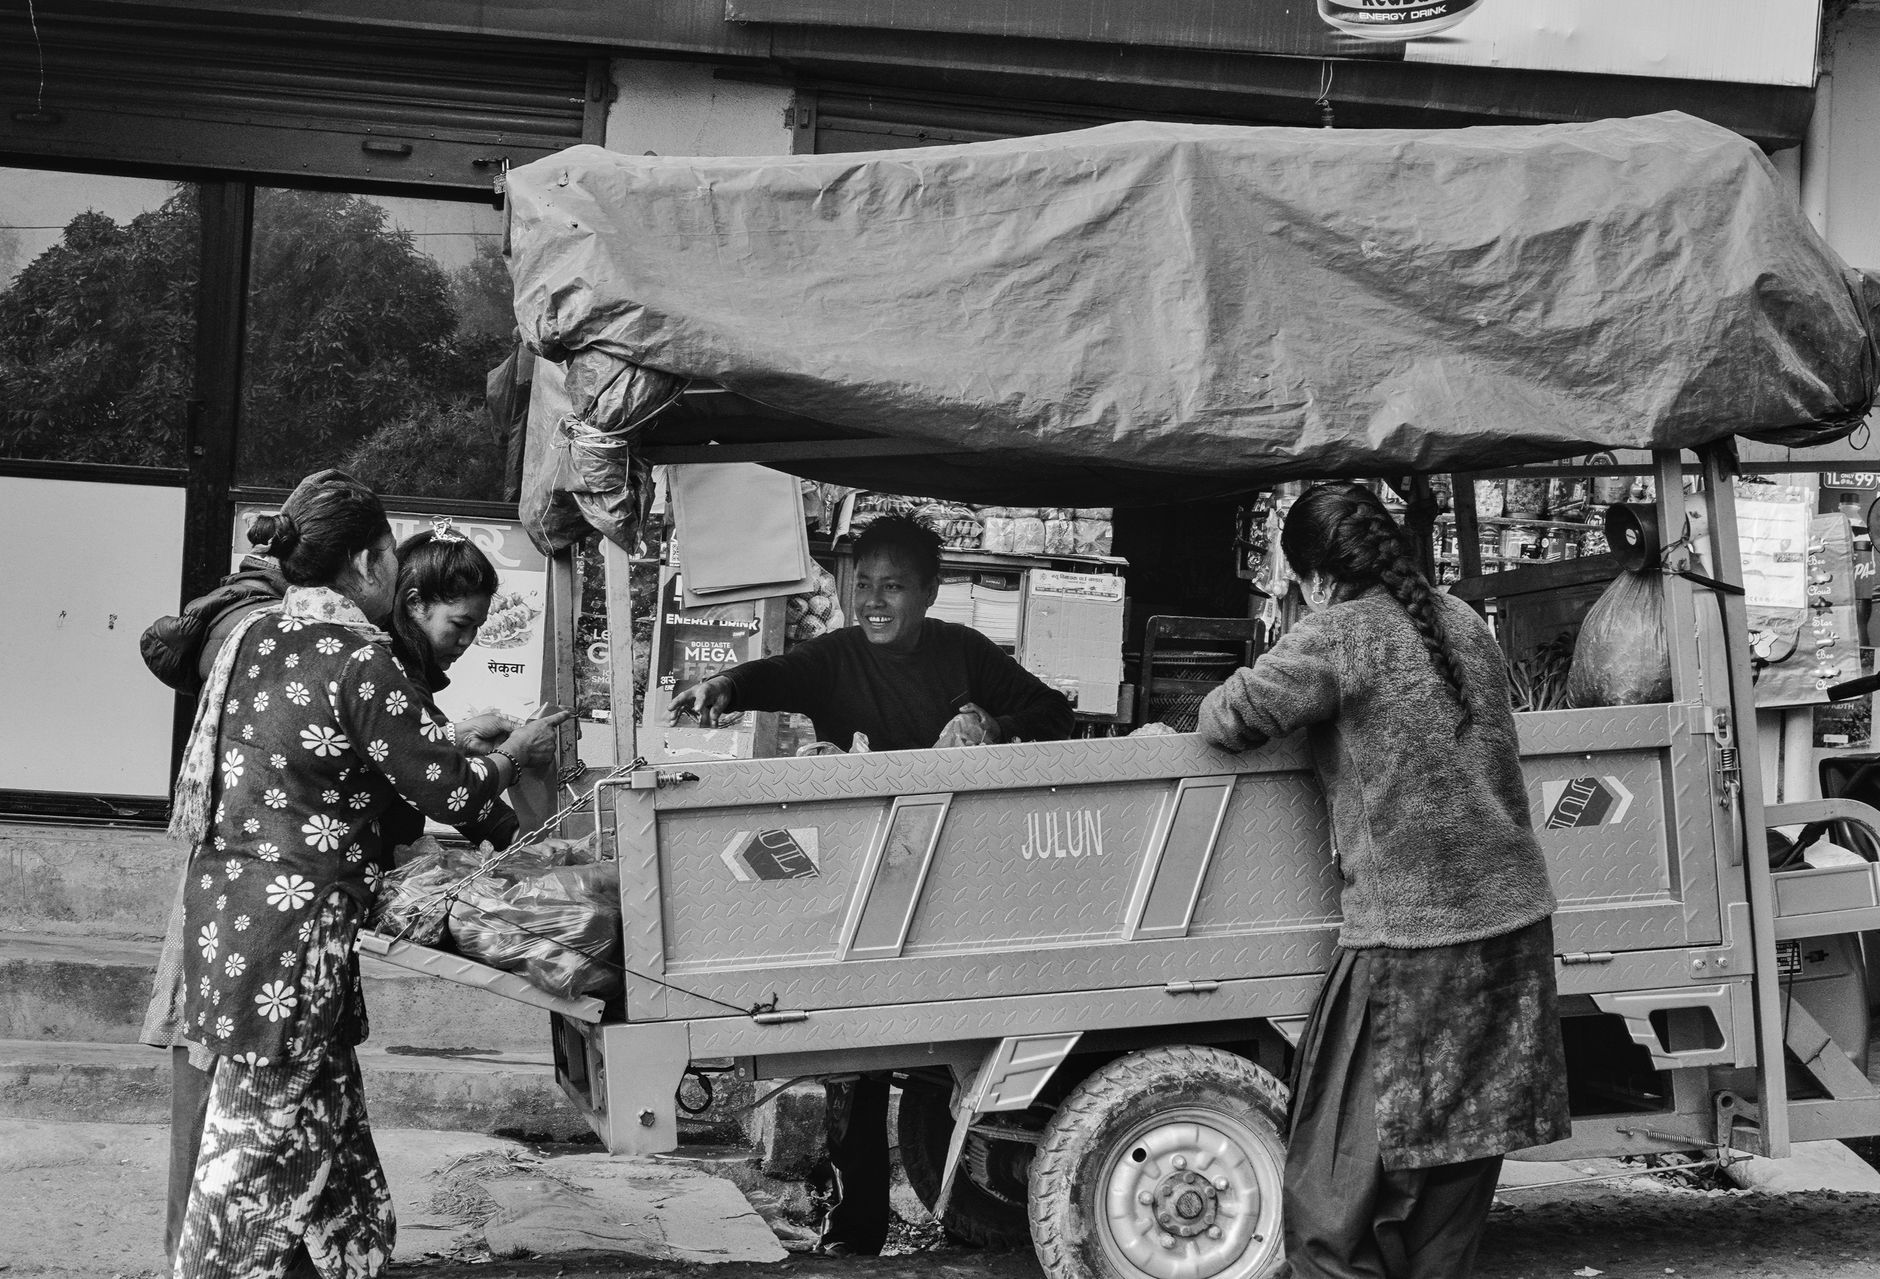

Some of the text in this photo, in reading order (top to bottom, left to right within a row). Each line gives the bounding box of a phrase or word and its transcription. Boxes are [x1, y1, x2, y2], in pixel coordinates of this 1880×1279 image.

[1359, 4, 1447, 21] ENERGY DRINK
[1827, 472, 1840, 485] 1L
[1855, 473, 1874, 486] 99
[1807, 585, 1832, 596] Cloud
[1812, 616, 1833, 627] Star
[684, 646, 738, 662] MEGA
[1816, 649, 1834, 660] Bee
[488, 659, 526, 678] सेकुवा
[1021, 810, 1103, 860] JULUN
